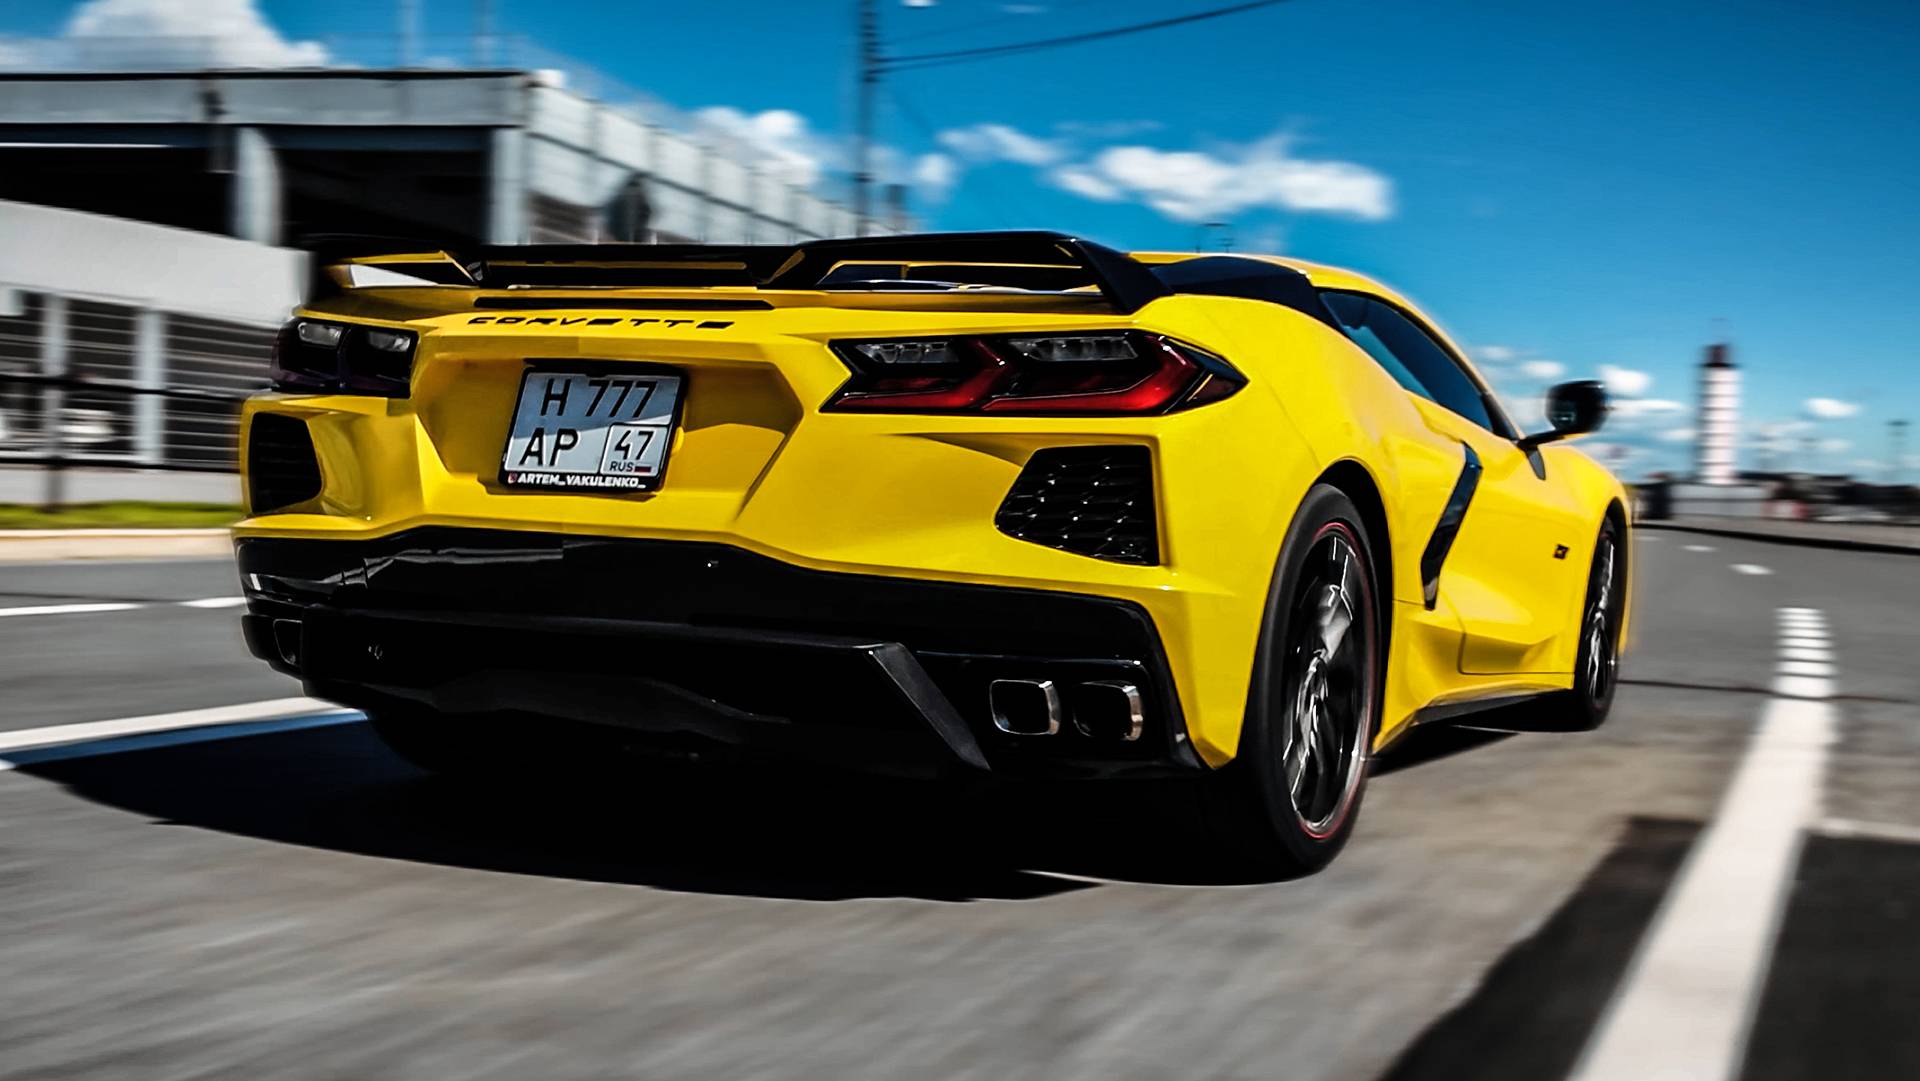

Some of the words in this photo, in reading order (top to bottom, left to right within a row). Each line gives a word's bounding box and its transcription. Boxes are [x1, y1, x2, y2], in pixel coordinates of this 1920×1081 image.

[467, 316, 735, 329] CORVETTE
[540, 378, 572, 416] H
[585, 379, 657, 418] 777
[518, 427, 579, 467] AP
[614, 430, 655, 461] 47
[609, 461, 635, 472] RUS
